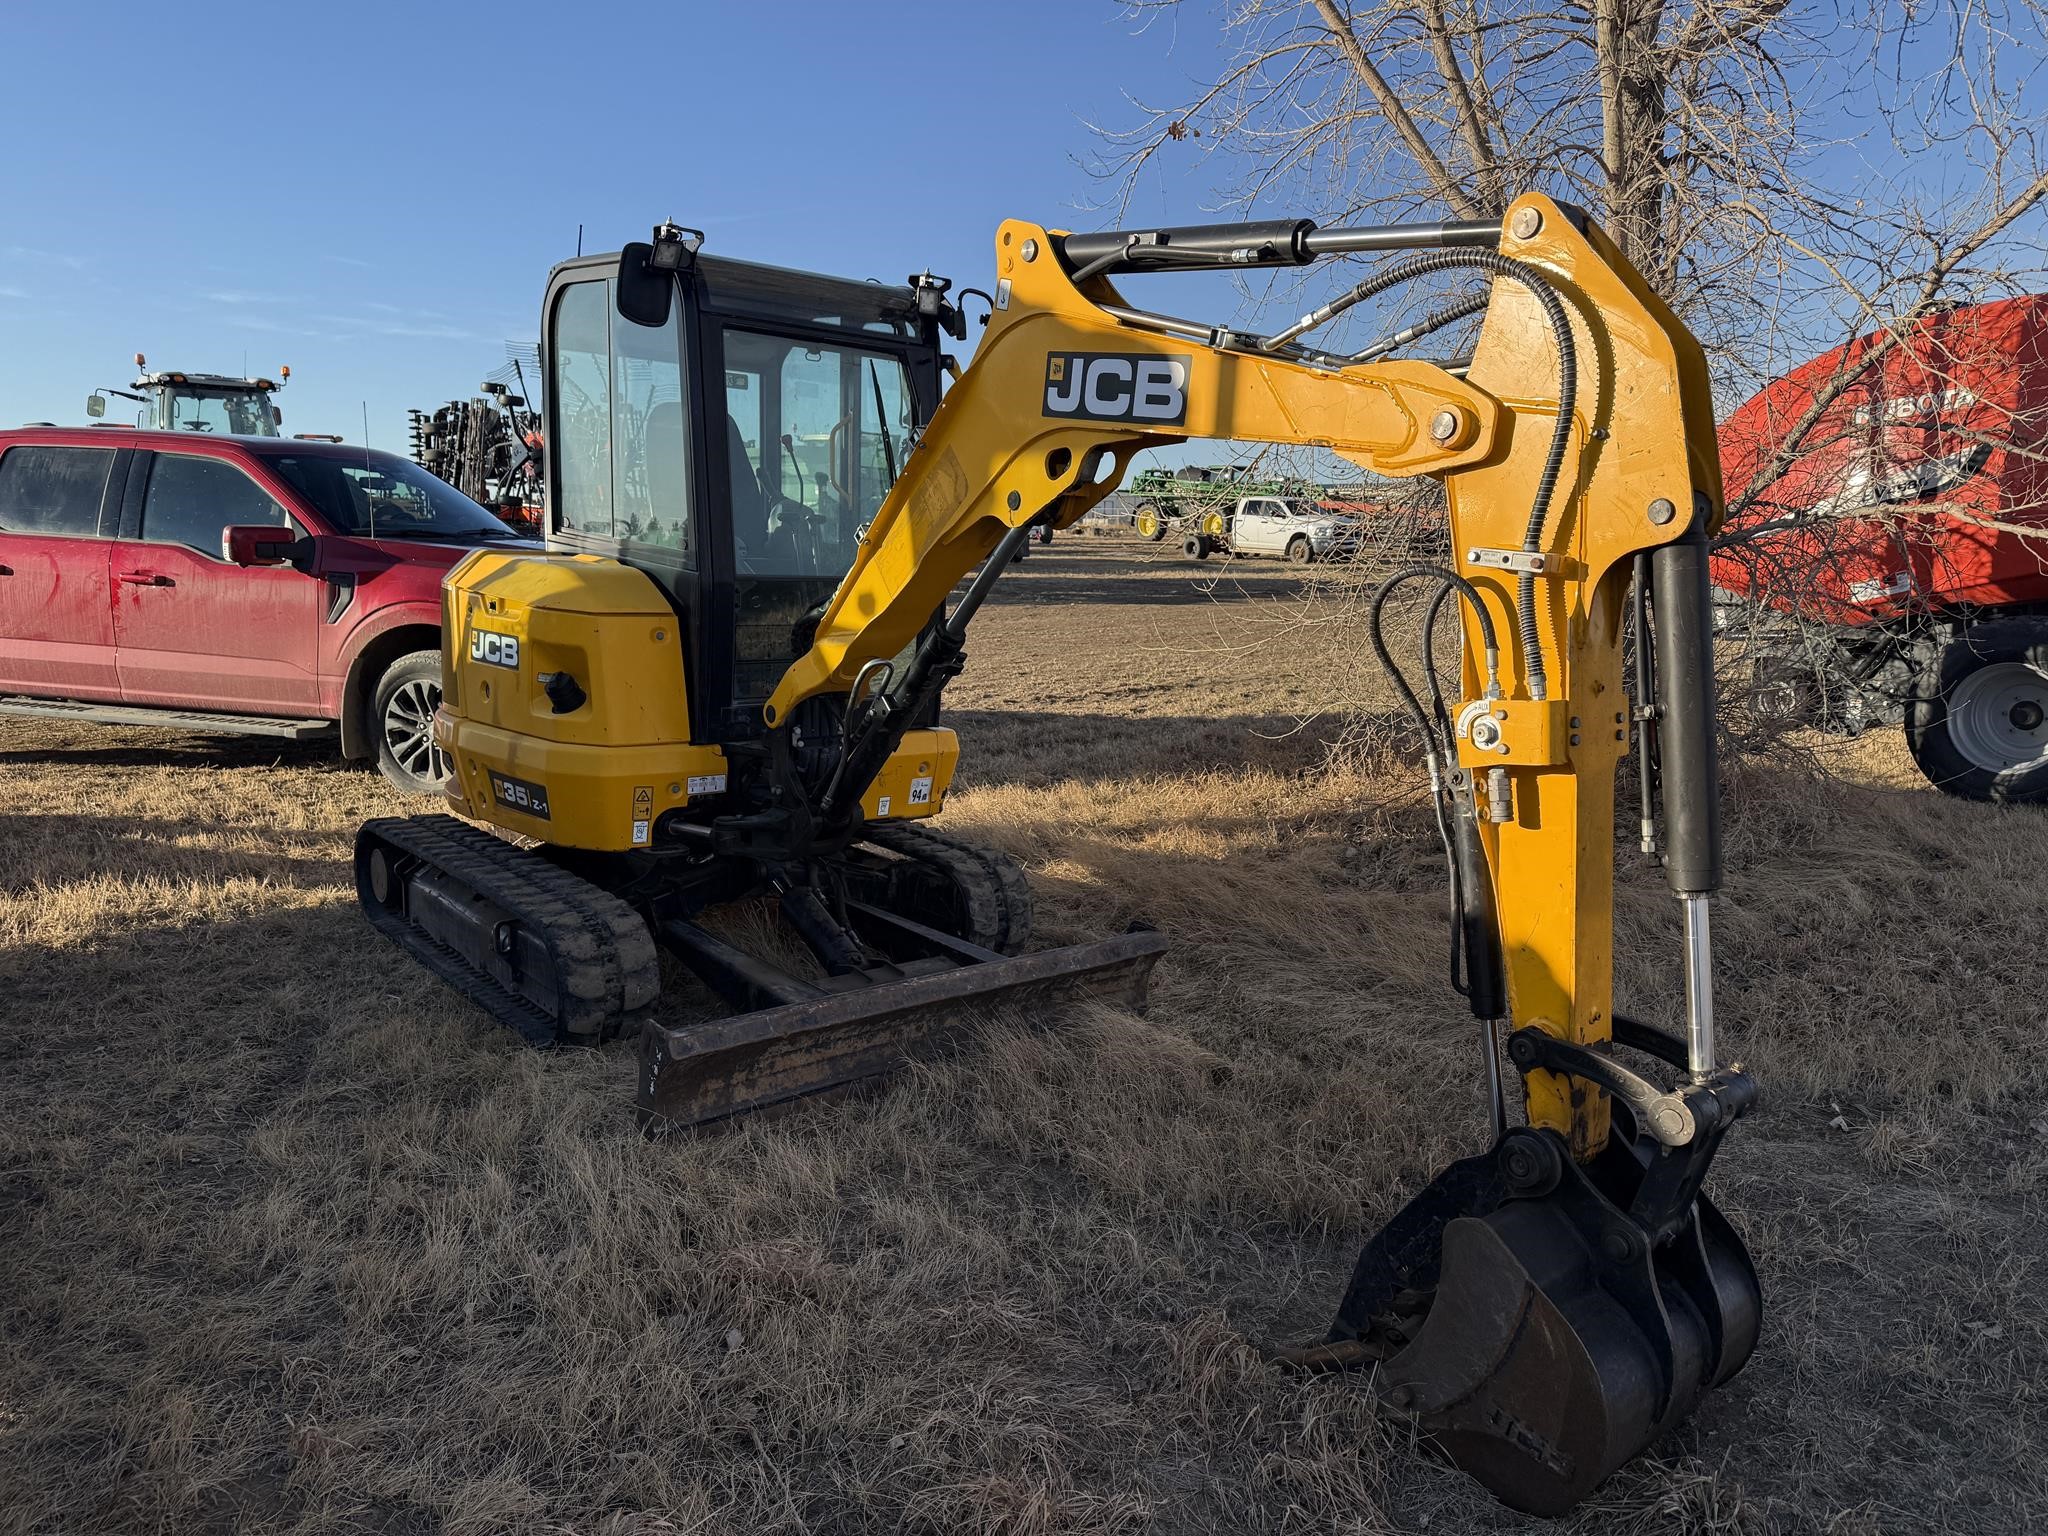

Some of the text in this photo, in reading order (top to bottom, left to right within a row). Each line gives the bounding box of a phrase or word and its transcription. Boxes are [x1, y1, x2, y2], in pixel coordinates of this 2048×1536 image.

[1047, 358, 1185, 419] JCB
[472, 631, 518, 666] JCB
[503, 781, 548, 813] 35 Z-1
[912, 788, 922, 802] 94
